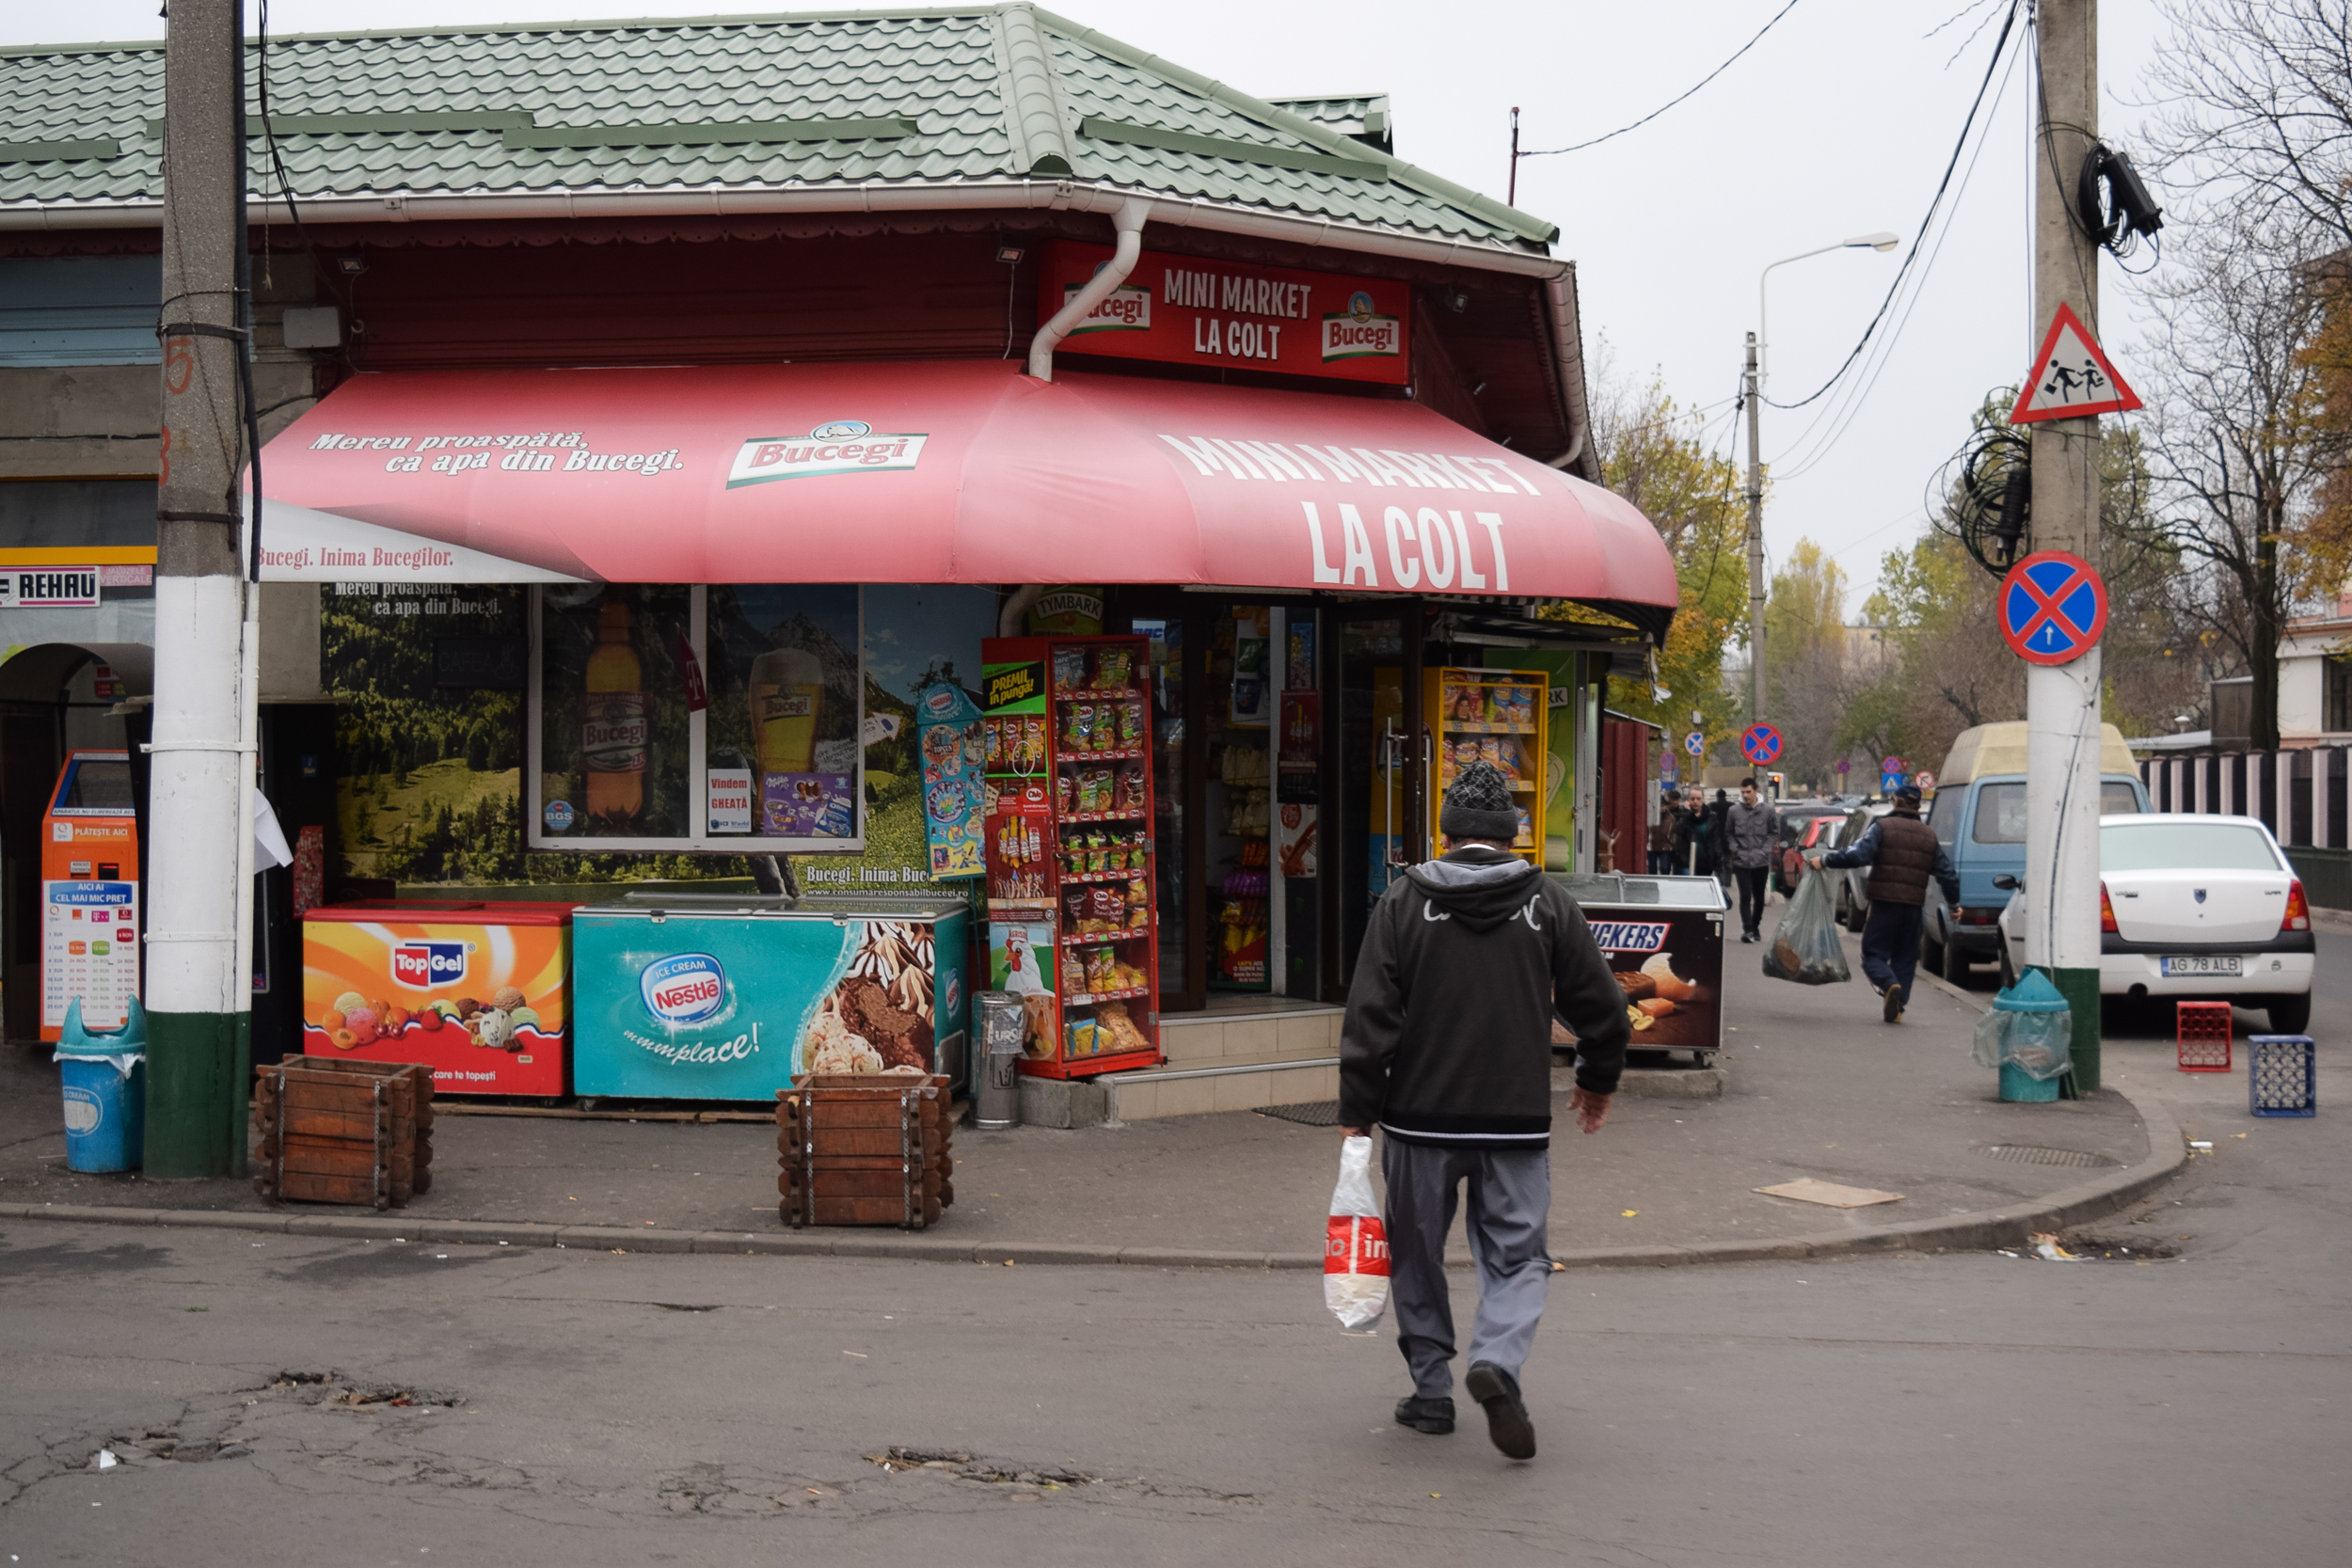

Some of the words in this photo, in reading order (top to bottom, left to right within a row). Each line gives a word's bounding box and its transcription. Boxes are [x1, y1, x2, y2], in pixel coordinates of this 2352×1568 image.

[1165, 269, 1216, 309] MINI
[1223, 276, 1311, 320] MARKET
[1072, 293, 1143, 324] ucegi
[1195, 318, 1221, 354] LA
[1228, 322, 1280, 360] COLT
[1329, 323, 1391, 350] Bucegi
[309, 434, 412, 451] Mereu
[414, 432, 589, 452] proaspătă,
[748, 438, 910, 468] Bucegi
[386, 455, 421, 472] ca
[430, 451, 490, 475] apa
[500, 450, 552, 471] din
[562, 450, 684, 476] Bucegi.
[1156, 434, 1327, 482] MINI
[1295, 443, 1541, 496] MARKET
[1301, 500, 1379, 587] LA
[1384, 505, 1508, 591] COLT
[320, 547, 366, 566] Inima
[373, 547, 453, 570] Bucegilor.
[20, 574, 95, 598] REHAU
[101, 575, 152, 583] VERTICALE
[374, 602, 390, 614] ca
[395, 601, 421, 618] apa
[425, 598, 447, 614] din
[452, 597, 502, 617] Bucegi.
[1039, 595, 1101, 617] TYMBARK
[586, 721, 644, 746] Bucegi
[711, 778, 747, 788] Vindem
[711, 798, 748, 811] GHEAȚĂ
[546, 812, 573, 820] BGS
[806, 865, 855, 885] Bucegi.
[860, 866, 898, 882] Inima
[655, 968, 671, 978] ICE
[672, 960, 707, 973] CREAM
[2170, 959, 2187, 970] AG
[2192, 959, 2209, 970] 78
[2213, 958, 2238, 970] ALB
[655, 979, 718, 1009] Nestlé
[455, 1070, 464, 1079] te
[466, 1070, 496, 1082] topești
[69, 1092, 89, 1101] CREAM
